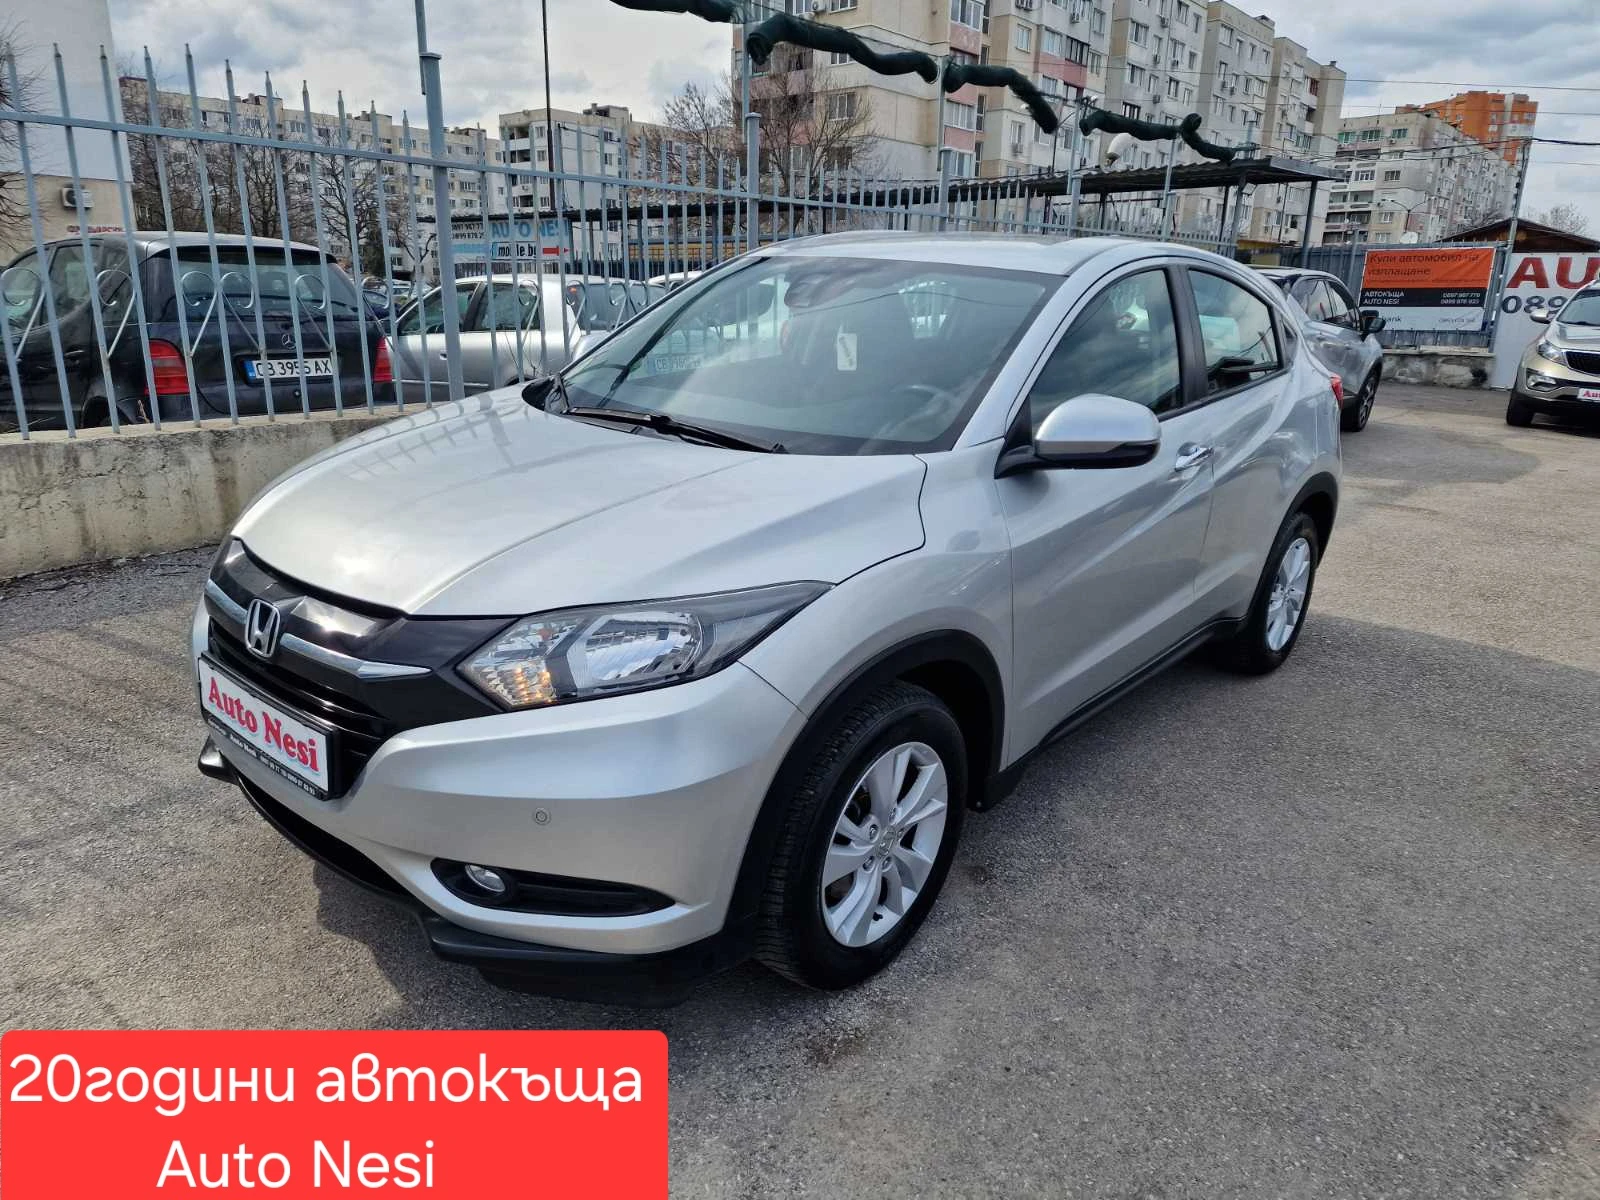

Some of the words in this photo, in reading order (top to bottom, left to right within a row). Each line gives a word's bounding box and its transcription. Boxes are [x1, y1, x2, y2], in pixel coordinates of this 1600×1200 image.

[315, 360, 332, 374] AX
[209, 677, 257, 733] Auto
[262, 711, 319, 772] Nesi
